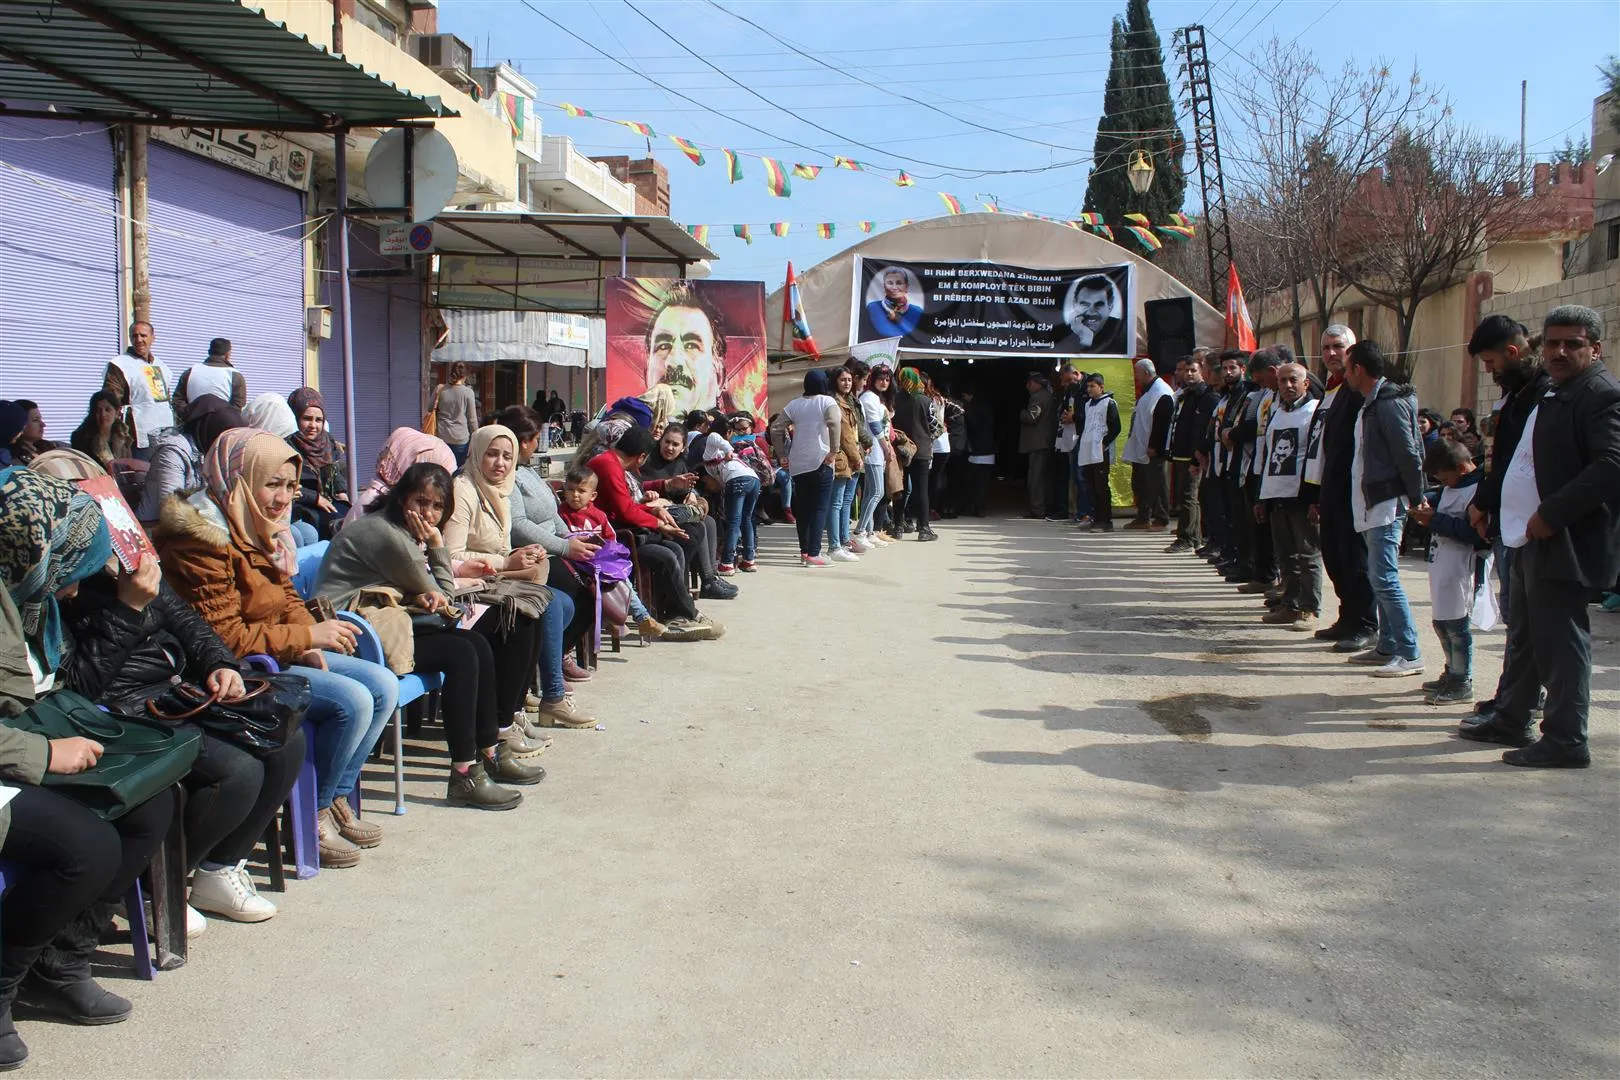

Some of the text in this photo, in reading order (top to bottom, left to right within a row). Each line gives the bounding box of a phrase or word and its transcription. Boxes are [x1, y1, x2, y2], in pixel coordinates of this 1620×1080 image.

[924, 268, 933, 276] BI
[935, 267, 956, 276] RIHÊ
[958, 269, 1016, 279] BERXWEDANA
[938, 281, 951, 289] EM
[960, 281, 1007, 291] KOMPLOYÊ
[1027, 284, 1052, 293] BIBIN
[944, 292, 973, 302] RÊBER
[974, 294, 992, 303] APO
[994, 295, 1006, 304] RE
[1007, 296, 1030, 305] AZAD
[986, 320, 1012, 330] السجون
[1012, 320, 1036, 331] مقاومة
[1037, 322, 1053, 331] بروح
[930, 333, 953, 345] أوجلان
[952, 335, 965, 344] الله
[965, 336, 978, 346] عبد
[978, 335, 998, 345] القائد
[998, 338, 1008, 347] مع
